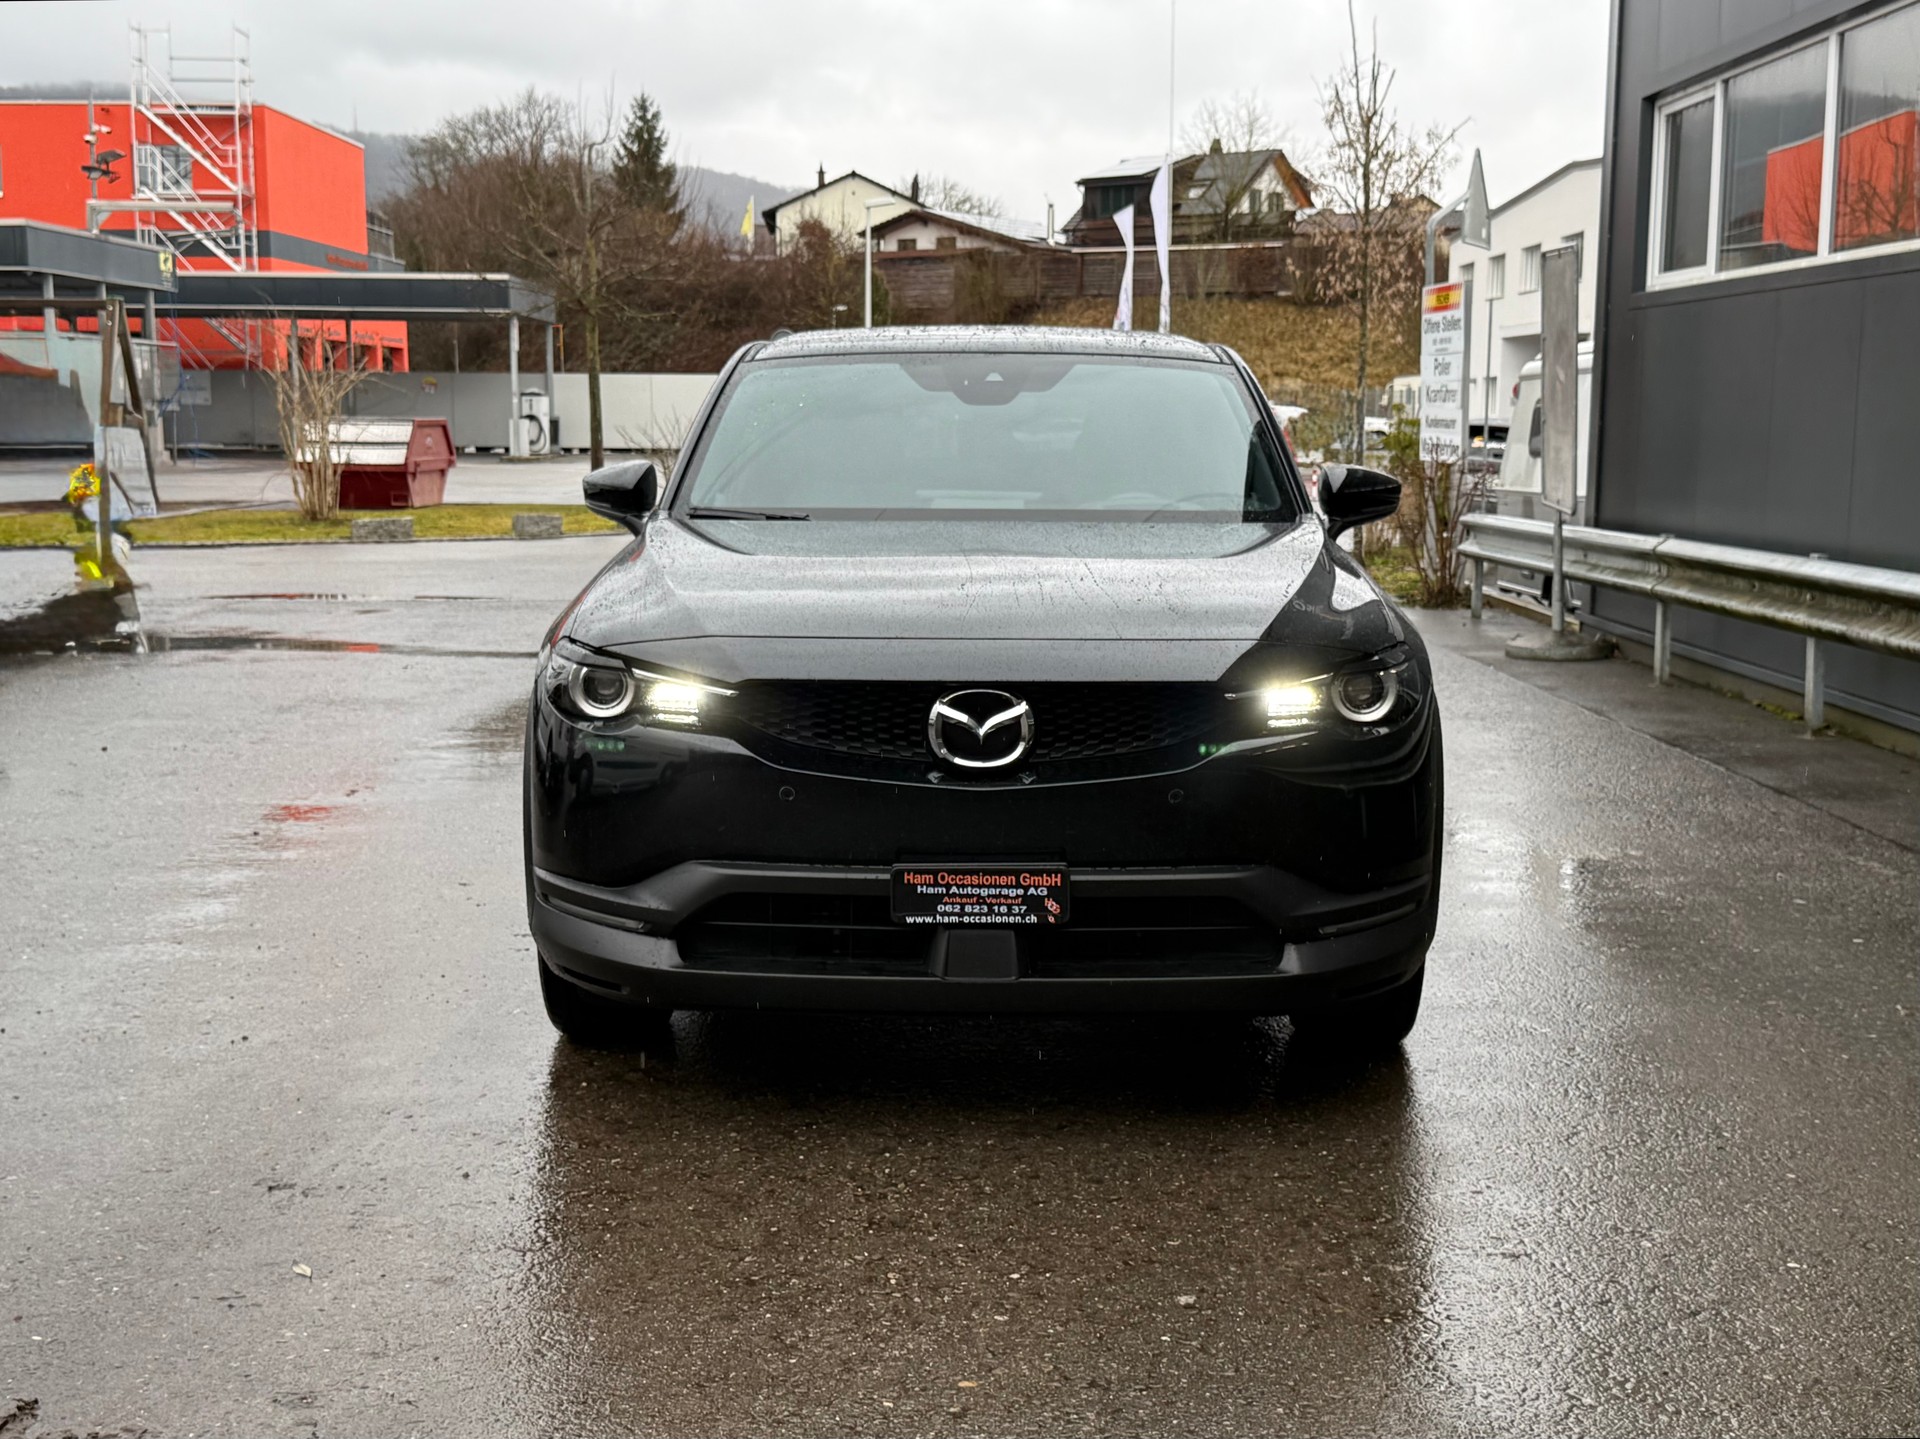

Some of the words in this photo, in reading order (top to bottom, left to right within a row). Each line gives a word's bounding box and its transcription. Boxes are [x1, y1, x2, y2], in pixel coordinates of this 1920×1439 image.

[904, 872, 933, 884] Ham
[937, 872, 1016, 886] Occasionen
[1019, 873, 1062, 886] GmbH
[917, 885, 946, 894] Ham
[949, 886, 1024, 896] Autogarage
[1027, 887, 1048, 896] AG
[942, 896, 978, 904] Ankauf
[937, 904, 961, 913] 062
[964, 905, 988, 913] 823
[992, 905, 1008, 913] 16
[1011, 906, 1027, 914] 37
[905, 914, 1038, 924] www.ham-occasionen.ch
